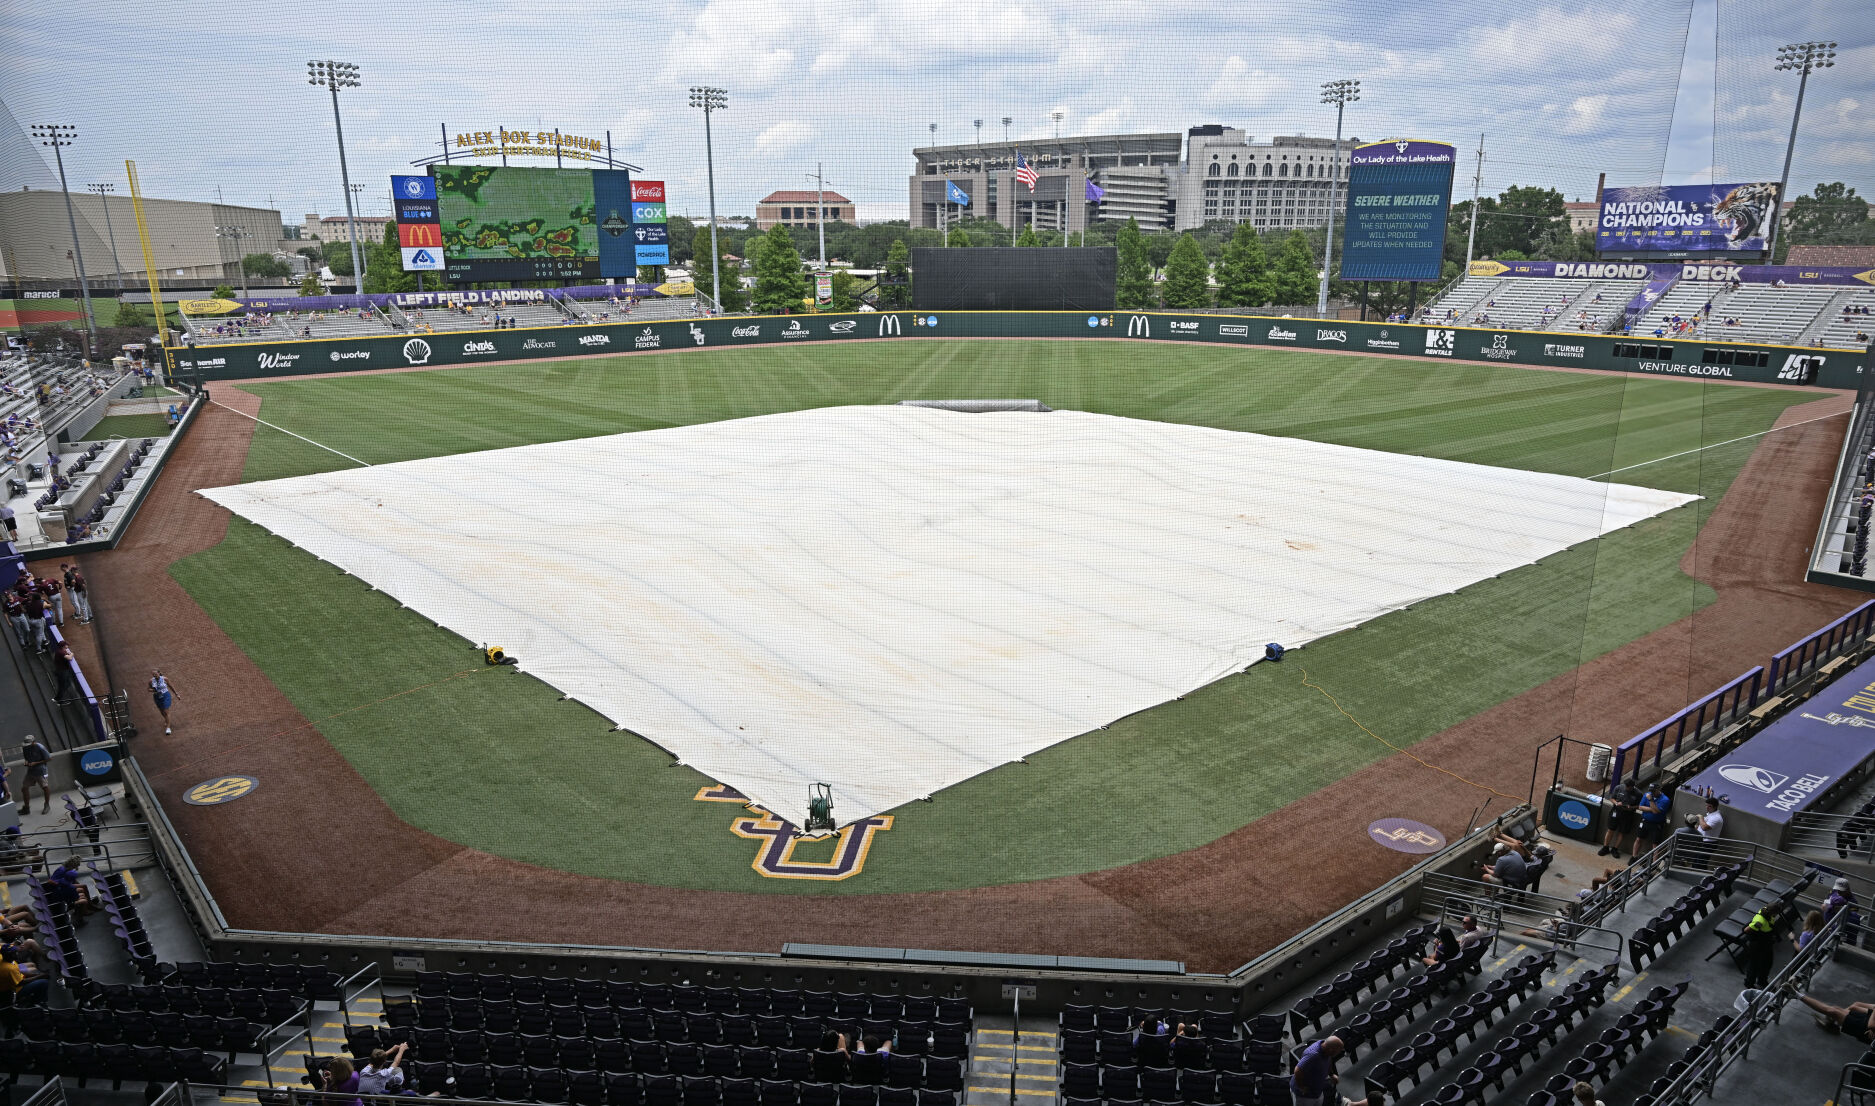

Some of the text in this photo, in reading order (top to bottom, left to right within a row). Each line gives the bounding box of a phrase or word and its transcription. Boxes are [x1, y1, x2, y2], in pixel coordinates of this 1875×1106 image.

[457, 130, 601, 152] ALEX BOX STADIUM
[472, 147, 498, 158] SKIP
[561, 147, 592, 160] FIELD
[944, 154, 1050, 166] TIGER STAIUM
[1368, 156, 1386, 164] Lady
[637, 187, 662, 197] Coca-Cola
[1354, 194, 1440, 206] SEVERE WEATHER
[636, 208, 662, 218] COX
[1604, 201, 1686, 214] NATIONAL
[1602, 213, 1704, 227] CHAMPIONS
[1555, 263, 1647, 278] DIAMOND
[1682, 266, 1744, 281] DECK
[24, 290, 60, 299] marucci
[396, 290, 544, 306] LEFT FIELD LANDING
[690, 323, 704, 345] LSU
[732, 326, 760, 337] Coca-Cola
[523, 341, 556, 349] ADVOCATE
[579, 335, 610, 344] MANDA
[1425, 329, 1455, 349] H&E
[341, 351, 370, 359] worley
[1481, 346, 1517, 356] BRIDGEWAY
[1638, 362, 1732, 376] VENTURE GLOBAL
[85, 760, 113, 771] NCAA
[1764, 774, 1830, 812] TACO BELL
[1560, 811, 1588, 826] NCAA
[1372, 827, 1441, 847] LSU
